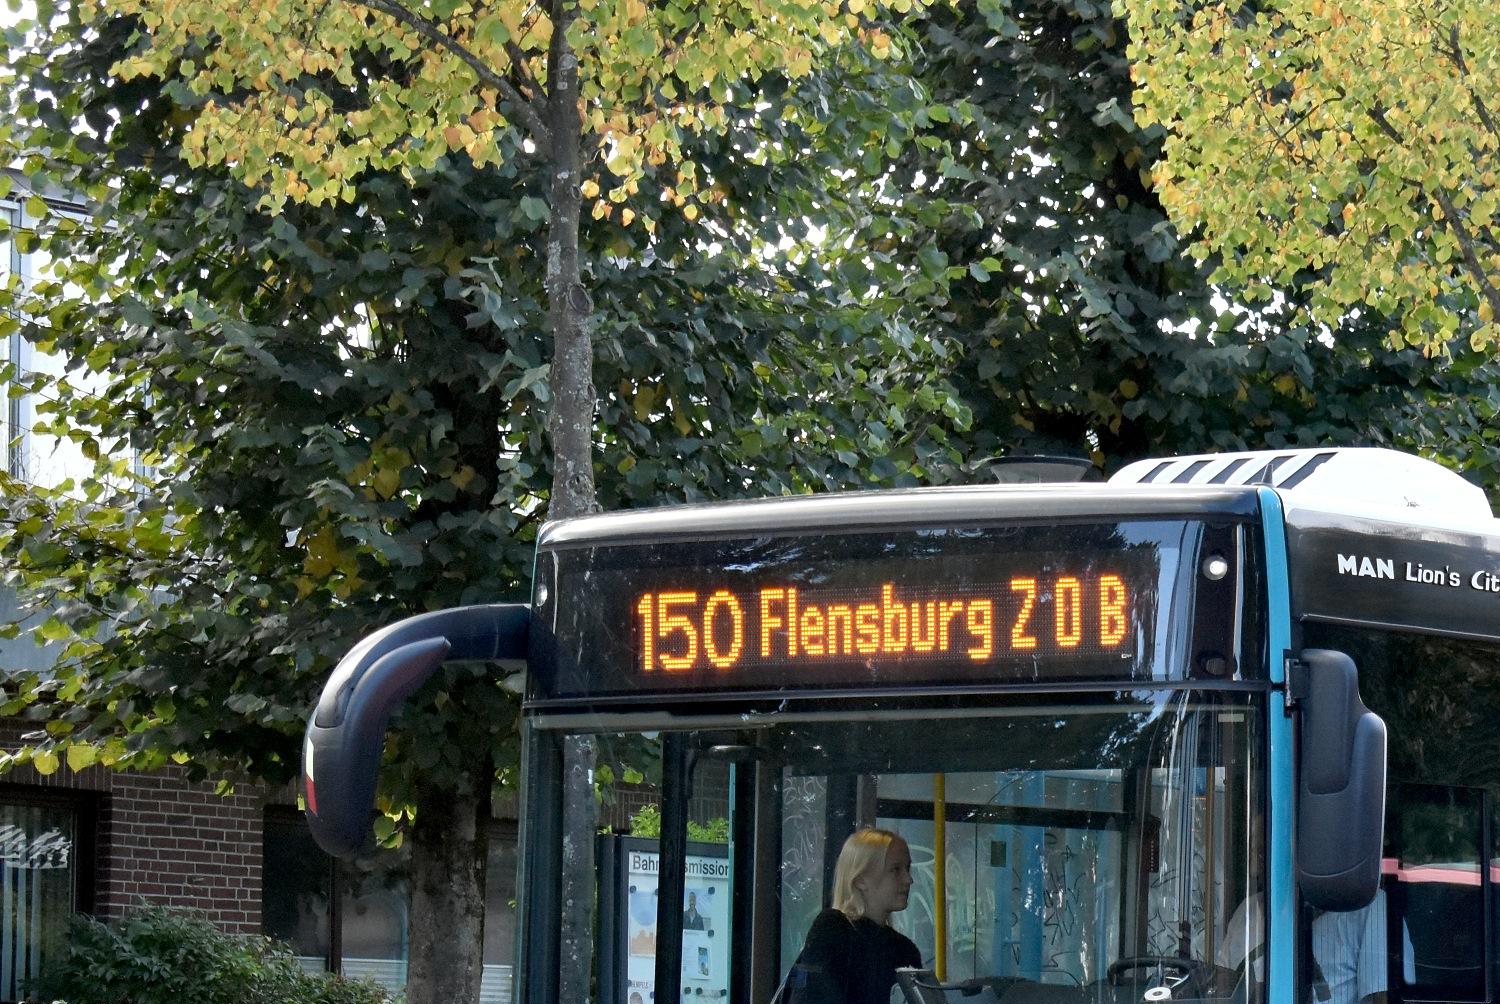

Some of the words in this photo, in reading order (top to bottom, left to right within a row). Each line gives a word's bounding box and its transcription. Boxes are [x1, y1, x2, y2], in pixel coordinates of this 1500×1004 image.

[1337, 553, 1395, 580] MAN
[1405, 562, 1461, 587] Lion's
[636, 590, 743, 671] 150
[760, 582, 993, 660] Flensburg
